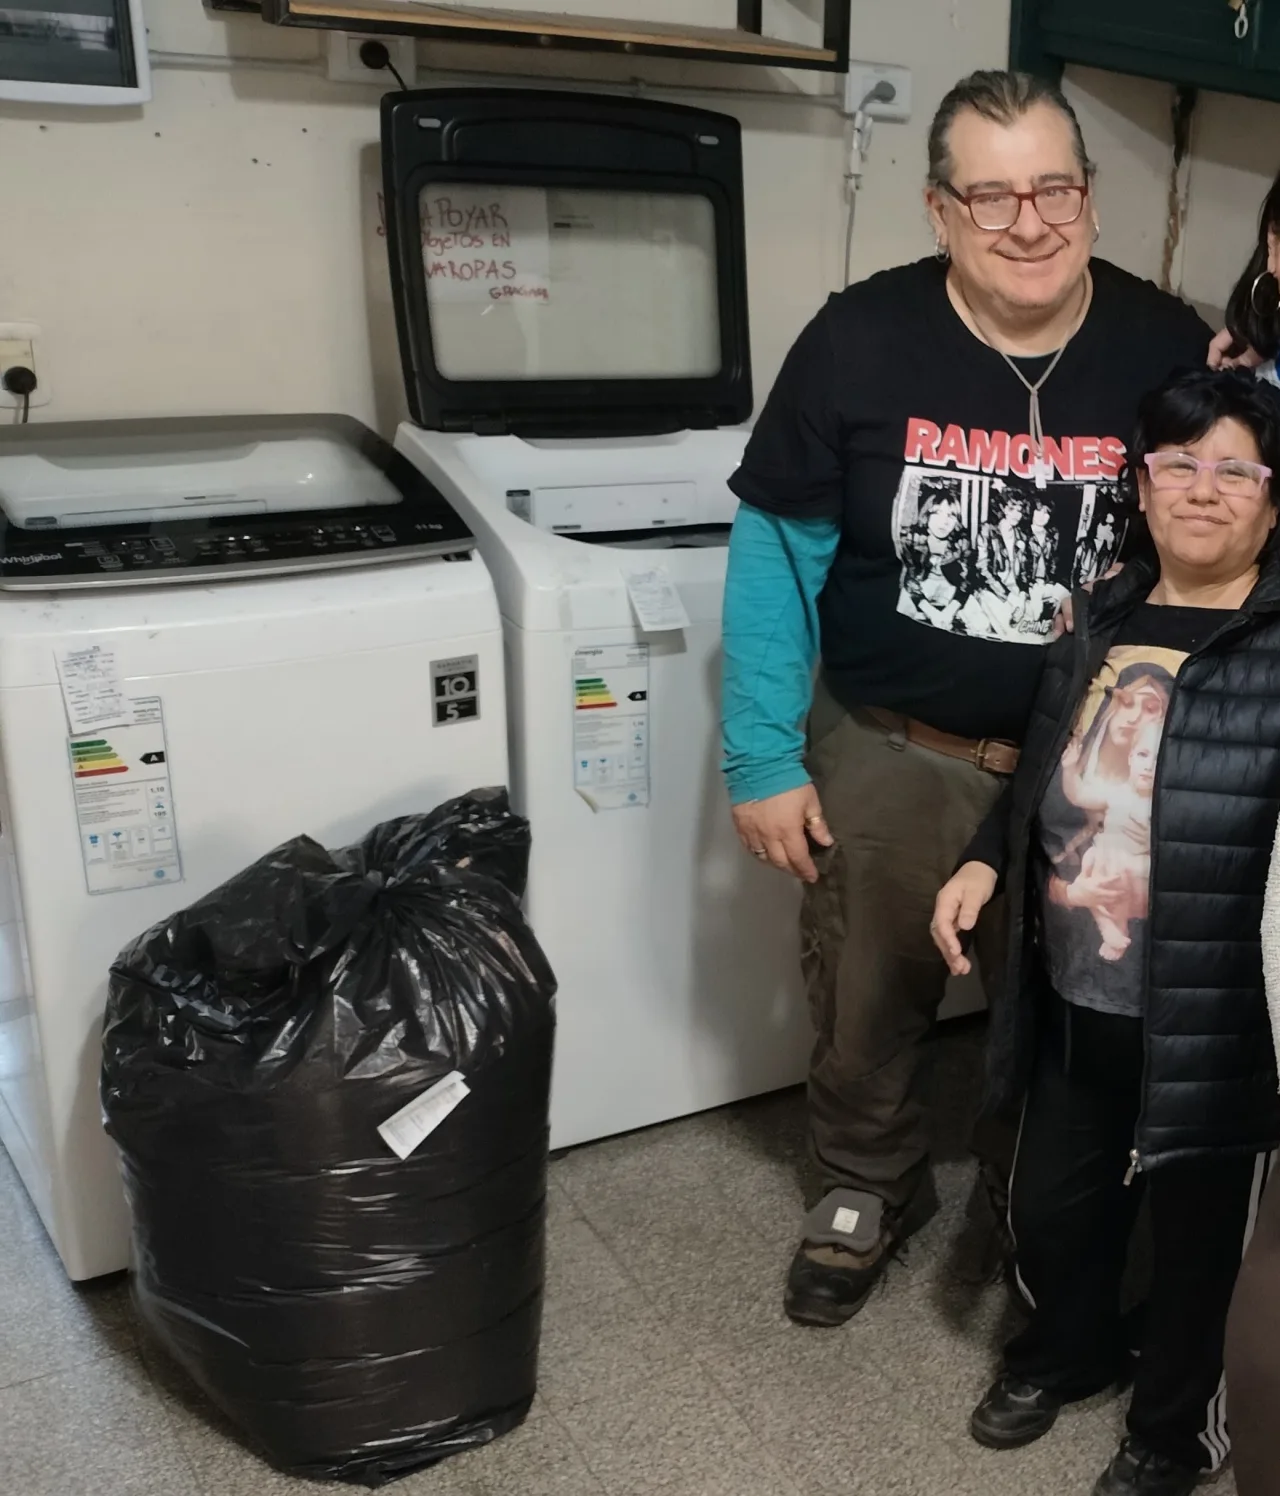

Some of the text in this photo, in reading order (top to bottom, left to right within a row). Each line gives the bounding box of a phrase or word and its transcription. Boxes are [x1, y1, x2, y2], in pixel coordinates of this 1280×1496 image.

[492, 231, 511, 248] EN
[425, 260, 517, 281] VAROPAS
[904, 417, 1128, 481] RAMONES
[0, 553, 63, 565] Whirlpool
[441, 676, 470, 697] 10
[446, 702, 460, 722] 5
[150, 754, 158, 762] A
